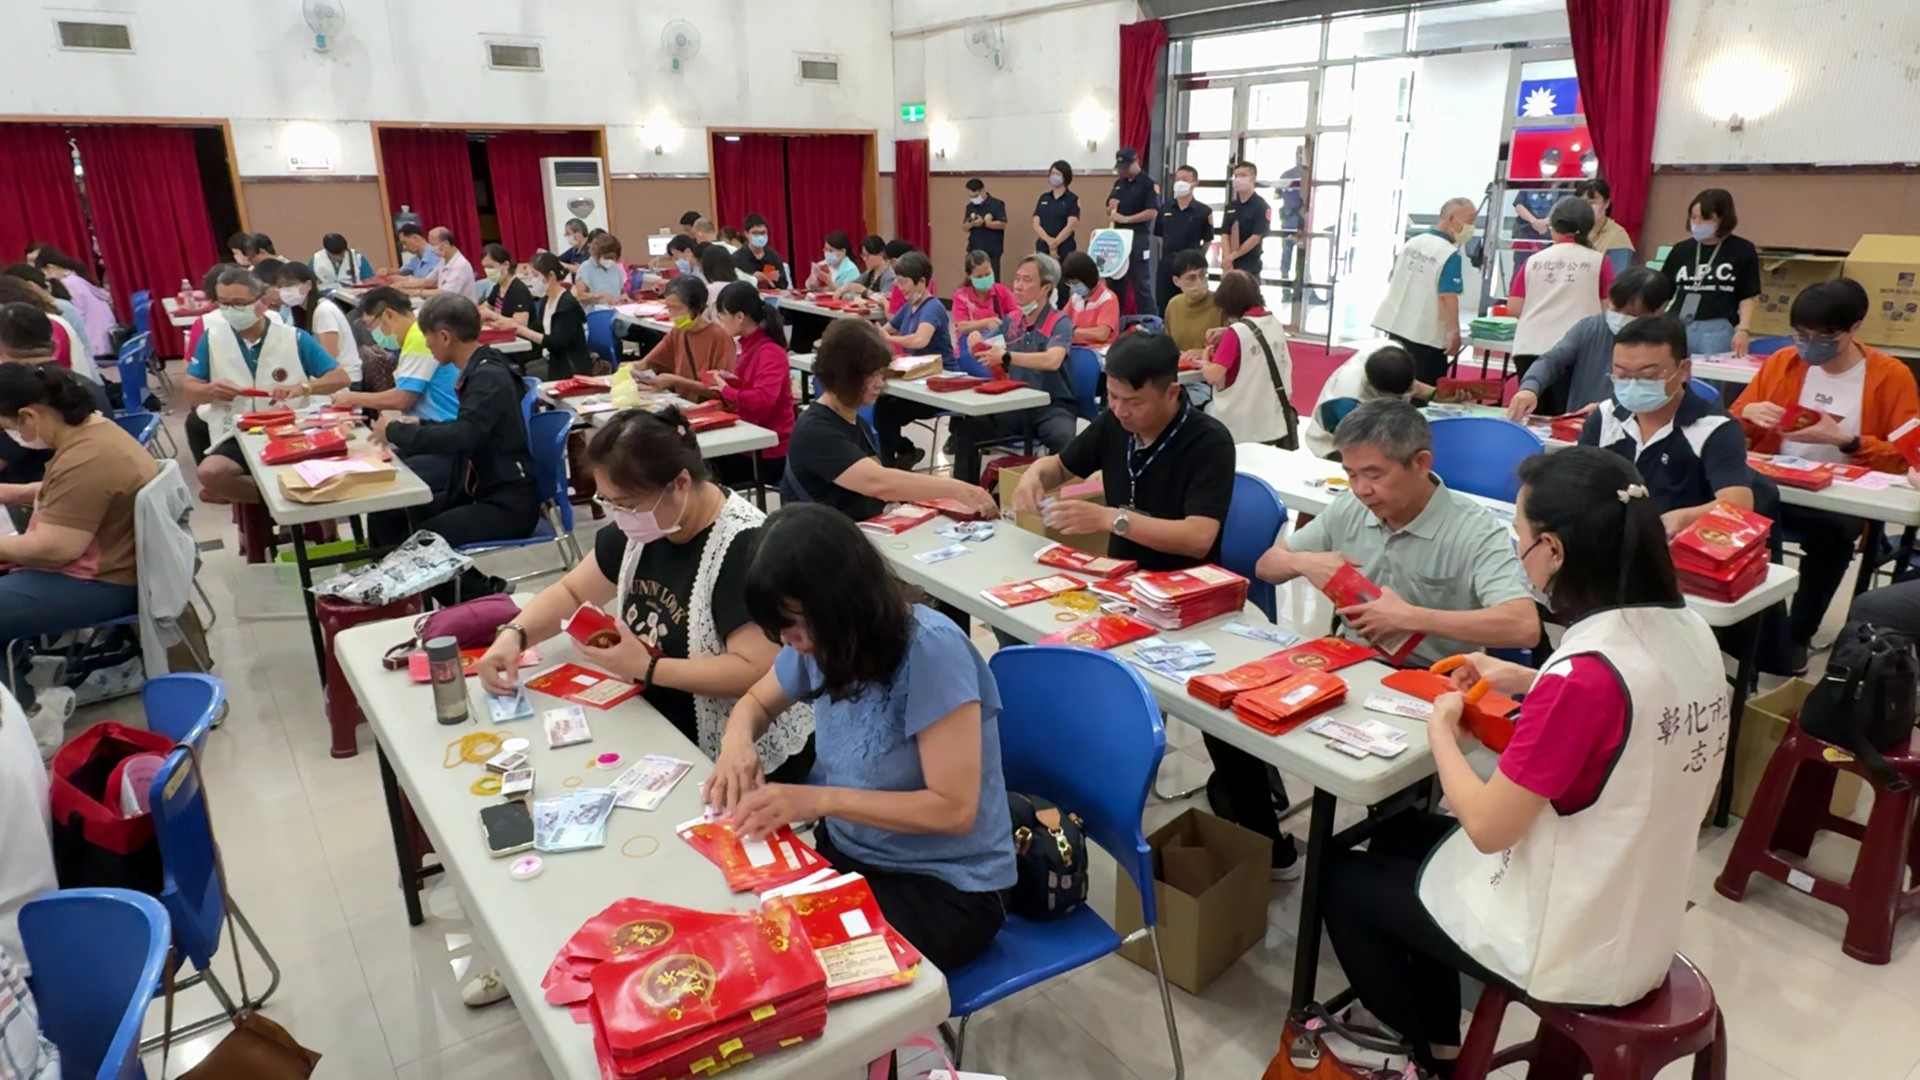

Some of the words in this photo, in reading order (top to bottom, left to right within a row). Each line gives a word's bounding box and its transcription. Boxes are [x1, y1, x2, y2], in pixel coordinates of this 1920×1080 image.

[1675, 262, 1736, 282] A.P.C.
[631, 579, 661, 596] UNN
[659, 587, 686, 625] LOOK
